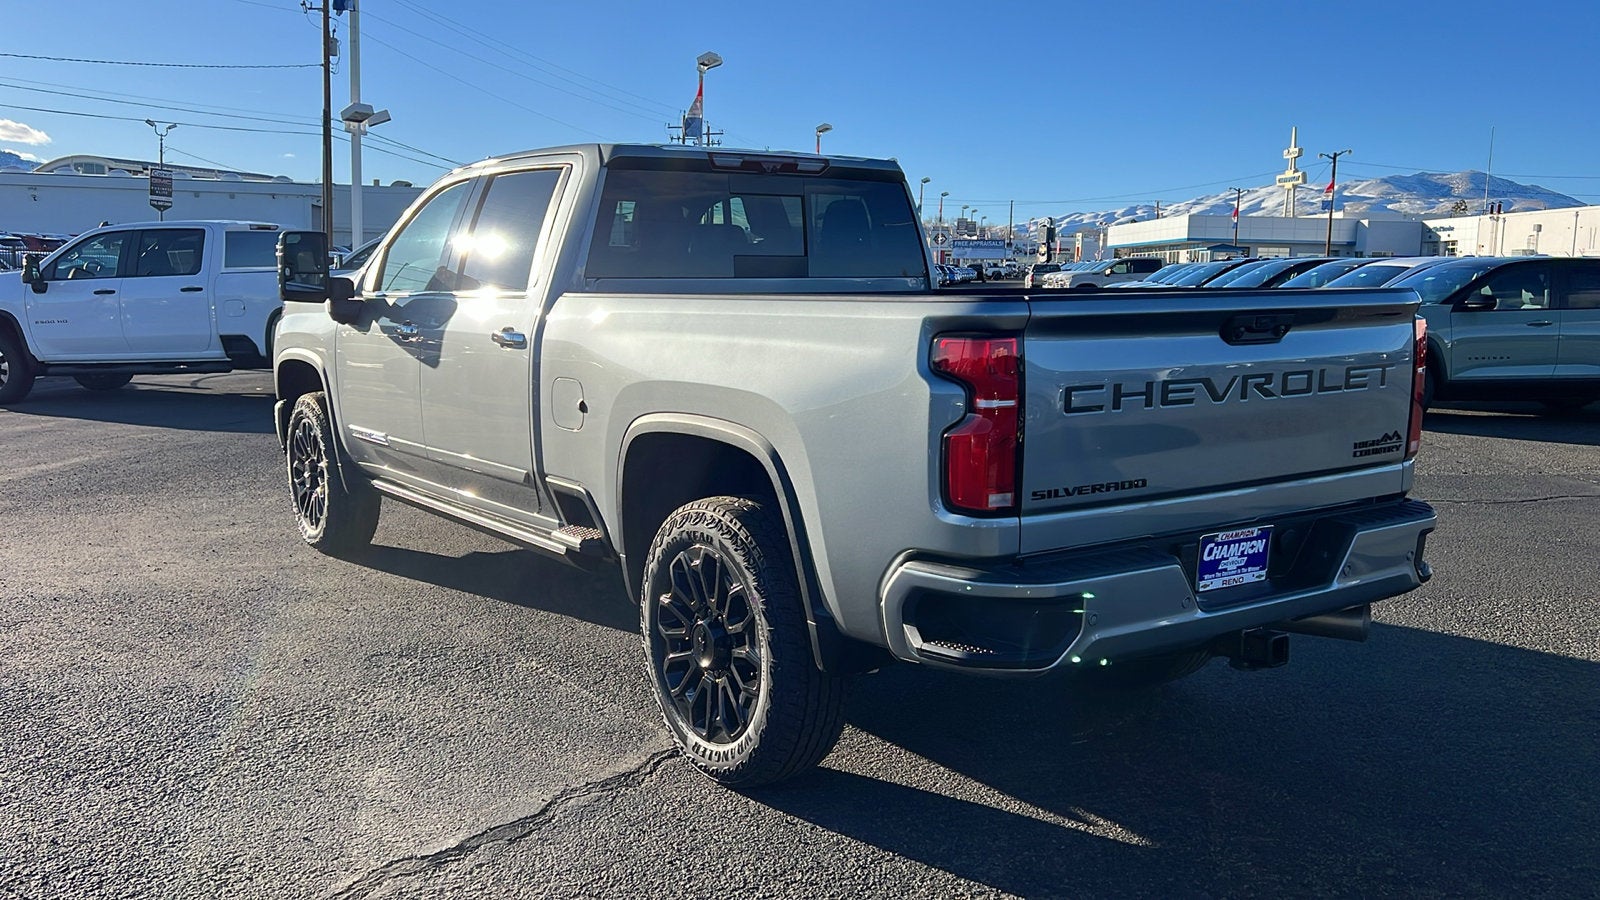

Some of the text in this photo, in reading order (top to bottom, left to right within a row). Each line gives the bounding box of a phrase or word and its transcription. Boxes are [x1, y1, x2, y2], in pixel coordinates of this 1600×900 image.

[1064, 363, 1396, 416] CHEVROLET
[1352, 443, 1402, 458] COUNTRY
[1031, 478, 1148, 501] SILVERADO
[1222, 530, 1255, 539] CHAMPION
[1203, 539, 1266, 561] CHAMPION
[1222, 576, 1244, 586] RENO
[691, 732, 752, 763] WRANGLER
